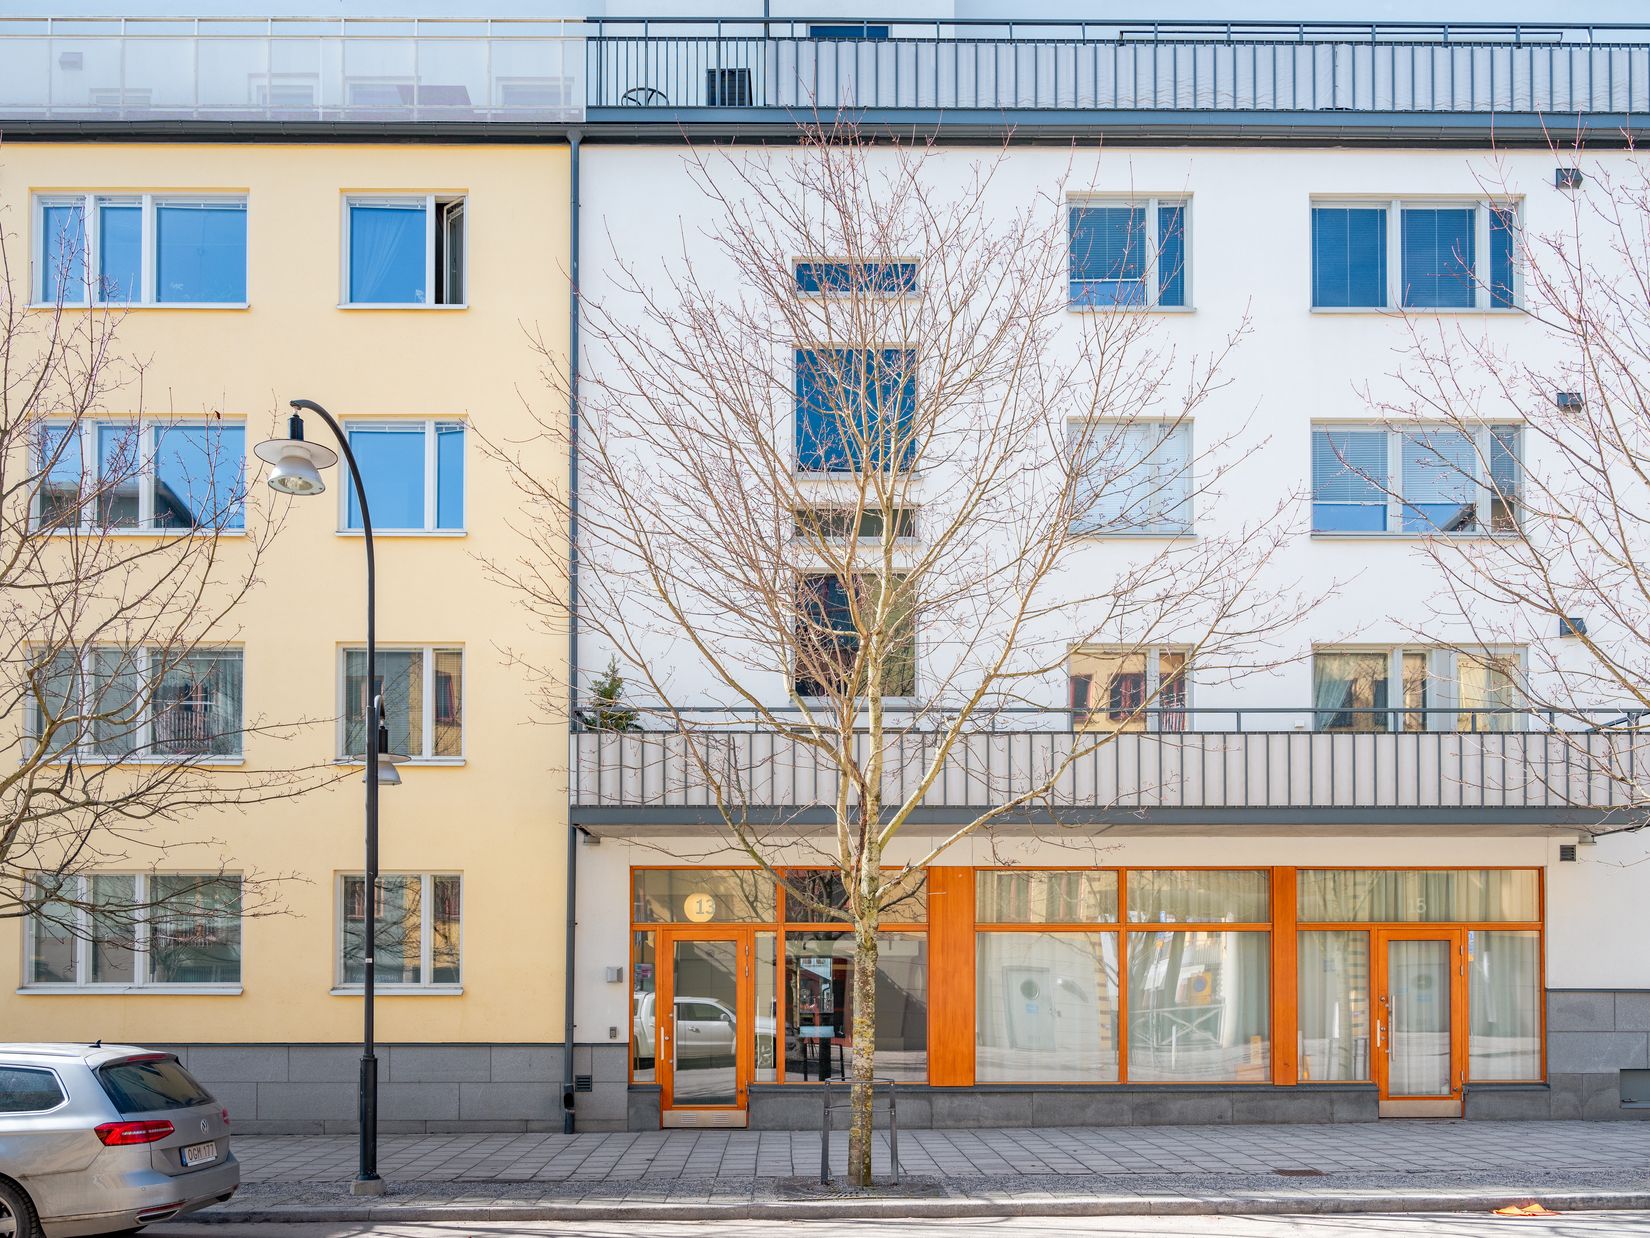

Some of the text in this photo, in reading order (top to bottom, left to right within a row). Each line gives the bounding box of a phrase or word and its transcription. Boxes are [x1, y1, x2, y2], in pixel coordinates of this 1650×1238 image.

[695, 899, 716, 915] 13
[187, 1143, 214, 1161] OGM 177
